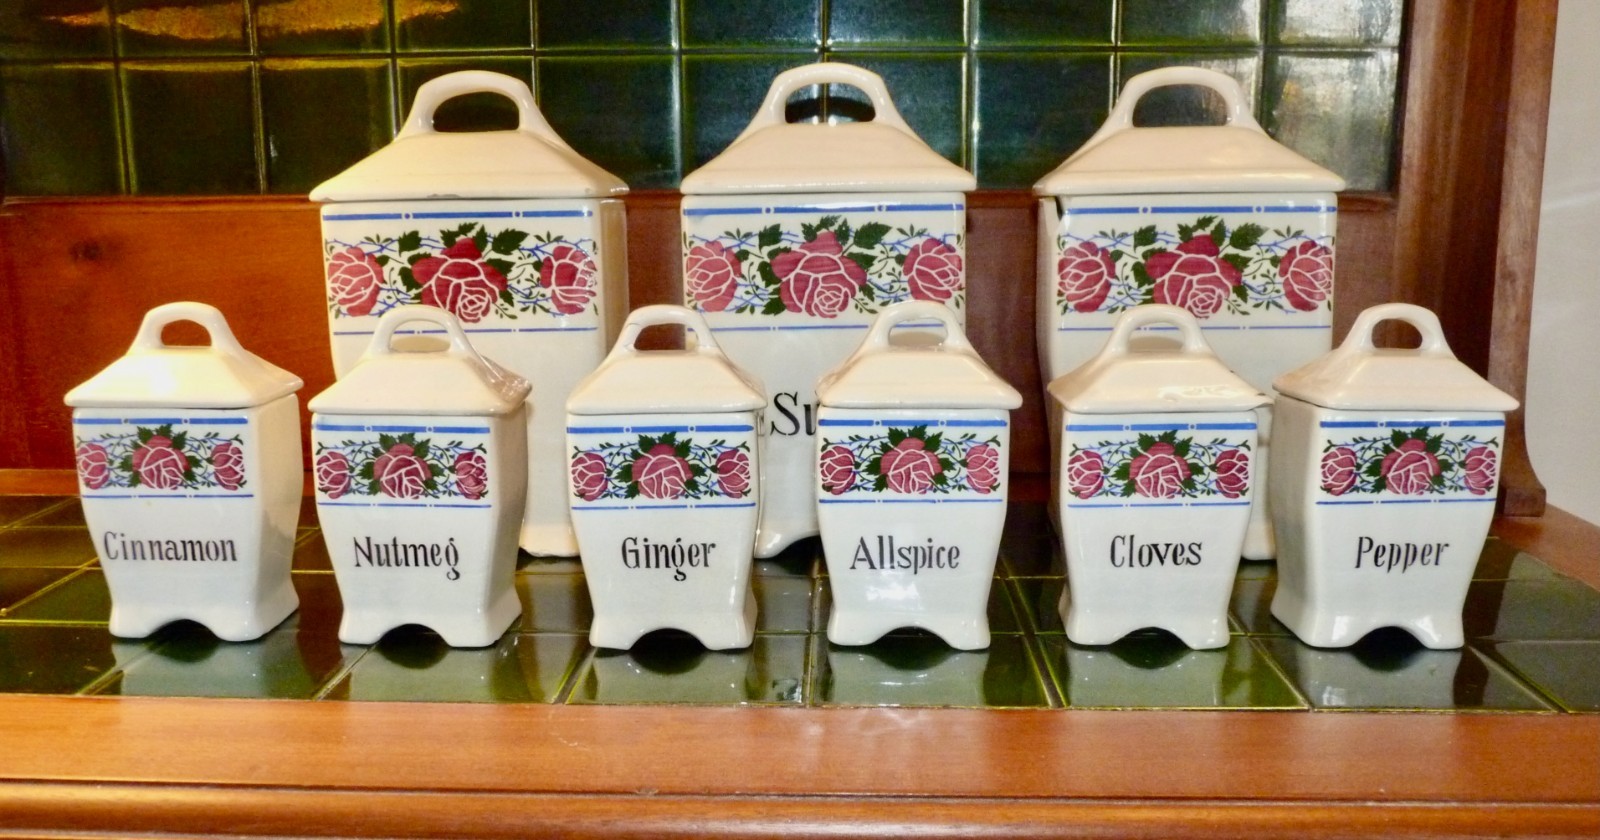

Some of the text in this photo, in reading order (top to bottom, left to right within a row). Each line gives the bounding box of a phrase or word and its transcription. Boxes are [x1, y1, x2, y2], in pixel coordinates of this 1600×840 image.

[103, 531, 237, 562] Cinnamon
[353, 536, 461, 581] Nutmeg
[621, 536, 716, 582] Ginger
[849, 535, 960, 575] Allspice
[1110, 534, 1202, 568] Cloves
[1354, 536, 1450, 574] Pepper
